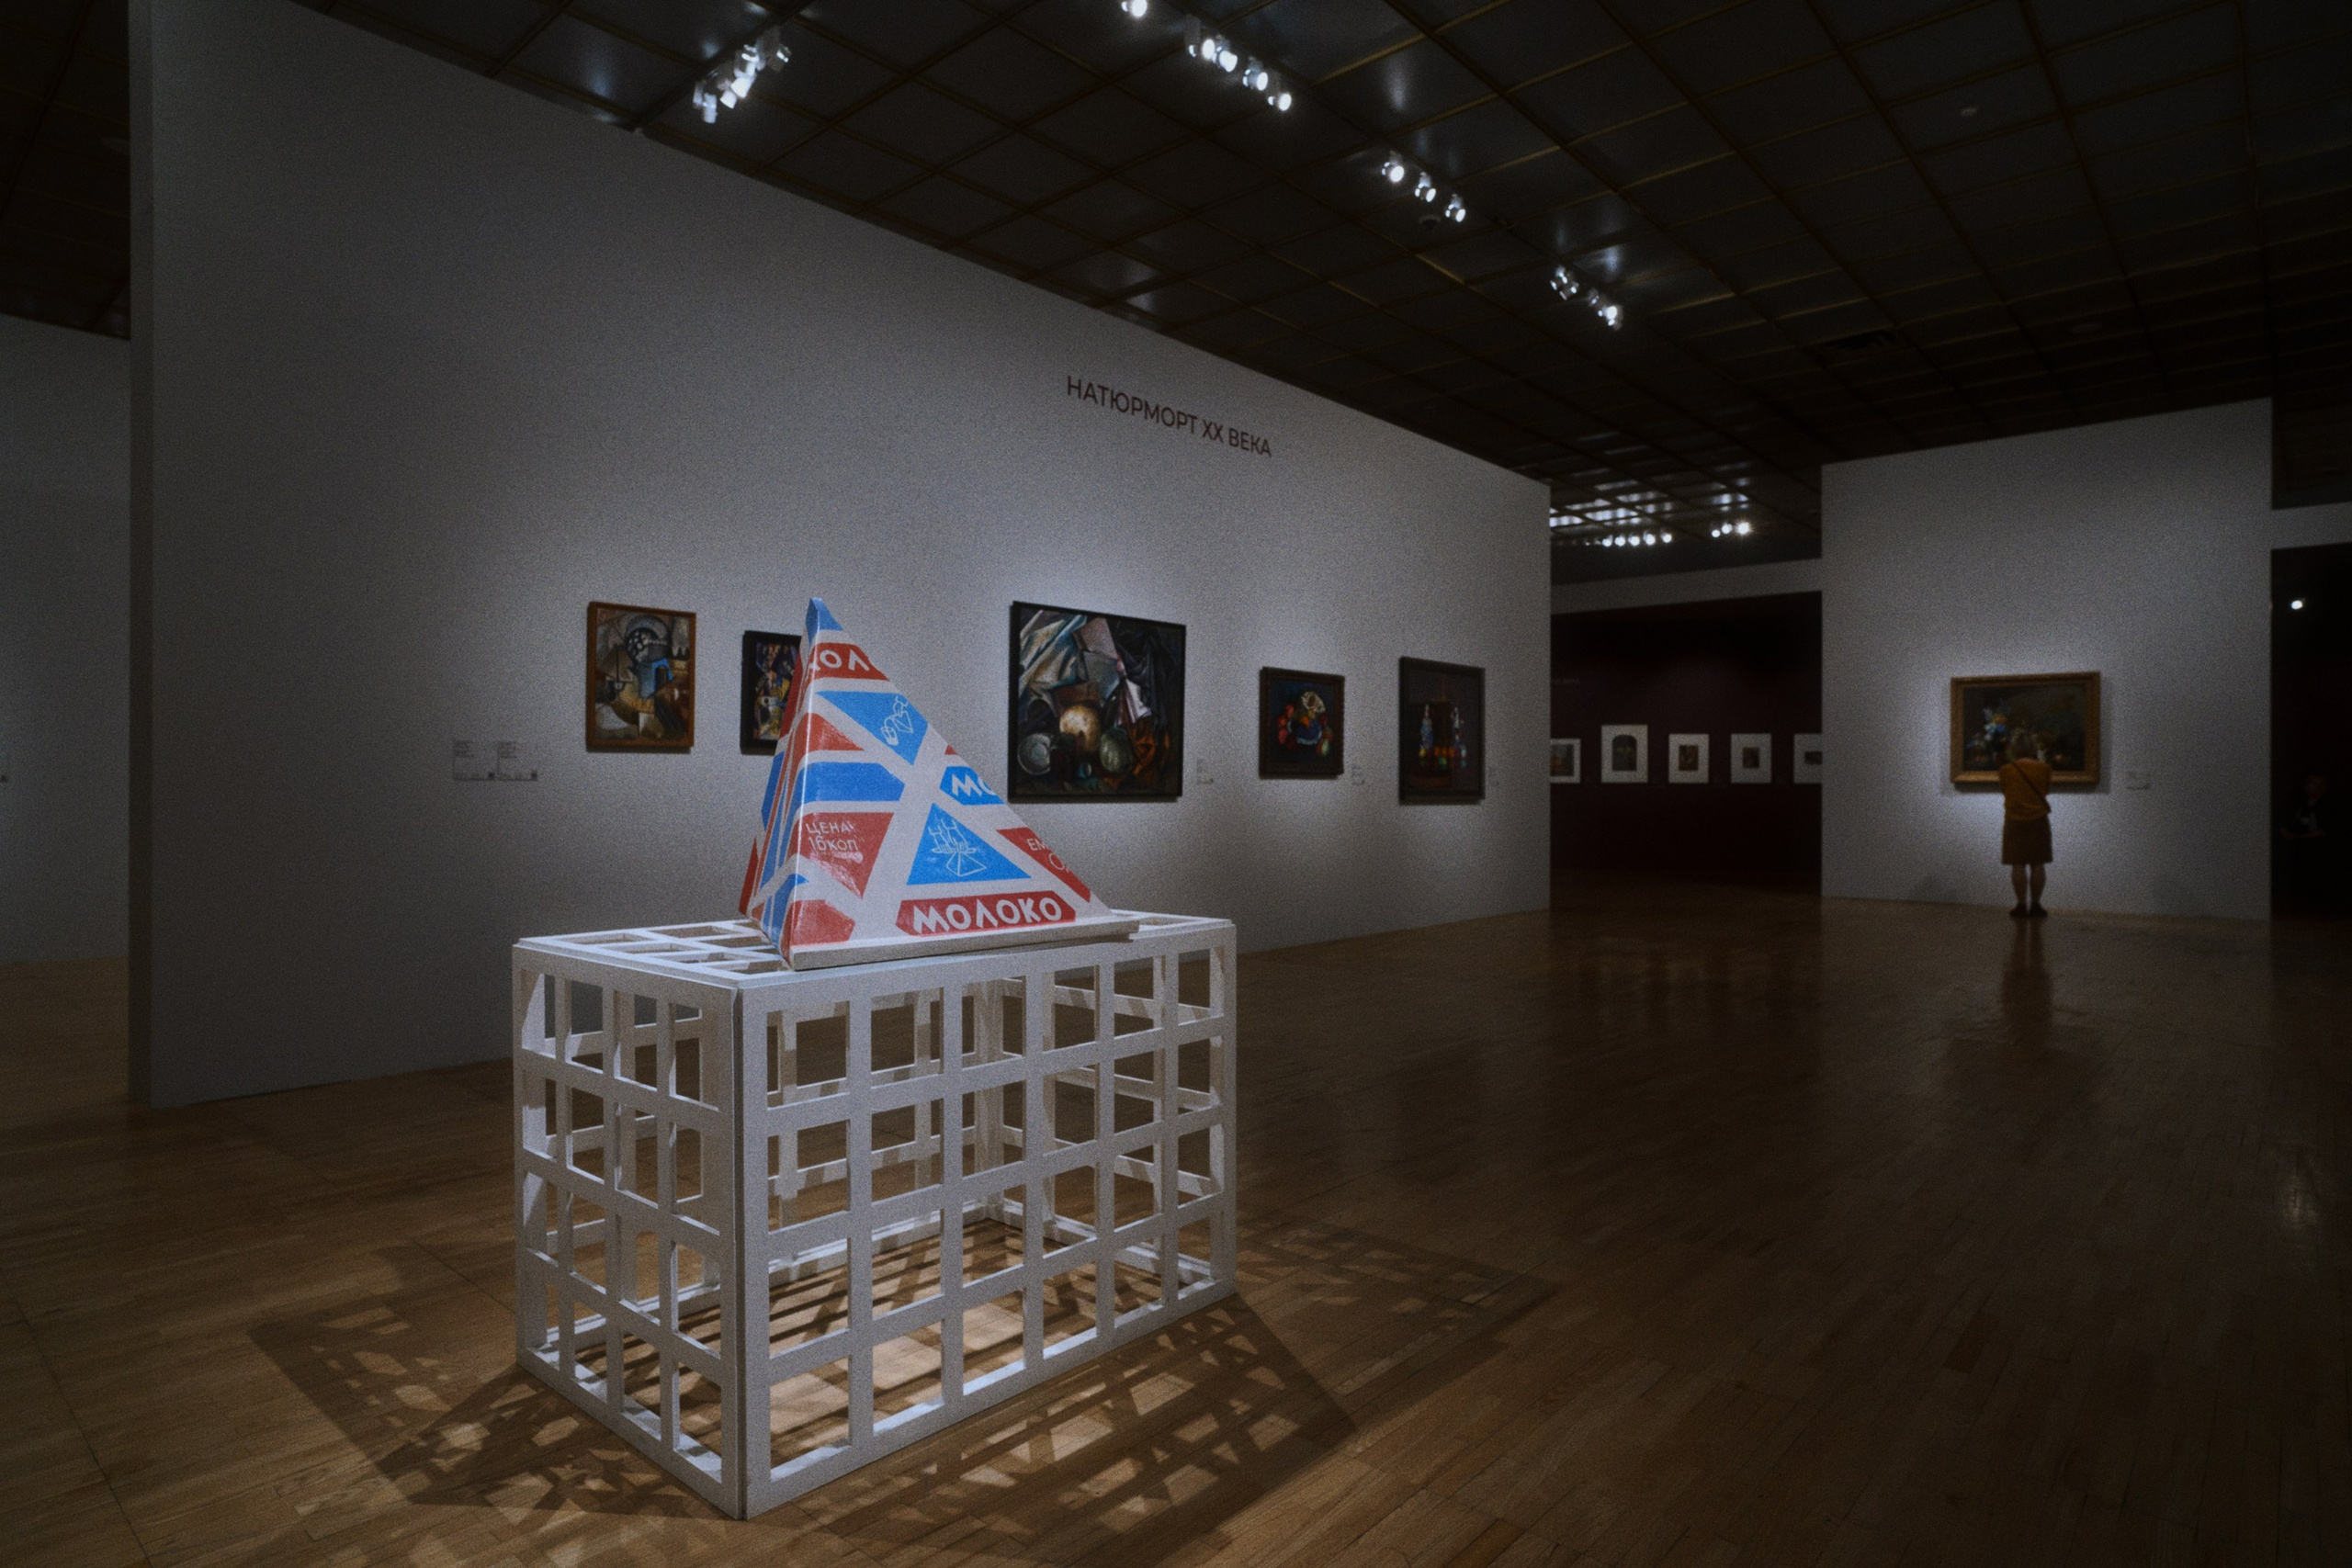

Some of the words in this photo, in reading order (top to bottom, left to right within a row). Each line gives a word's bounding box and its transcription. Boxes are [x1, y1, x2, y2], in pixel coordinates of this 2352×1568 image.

[1067, 375, 1197, 434] НАТЮРМОРТ
[1228, 428, 1272, 457] ВЕКА
[913, 897, 1062, 934] МОЛОКО
